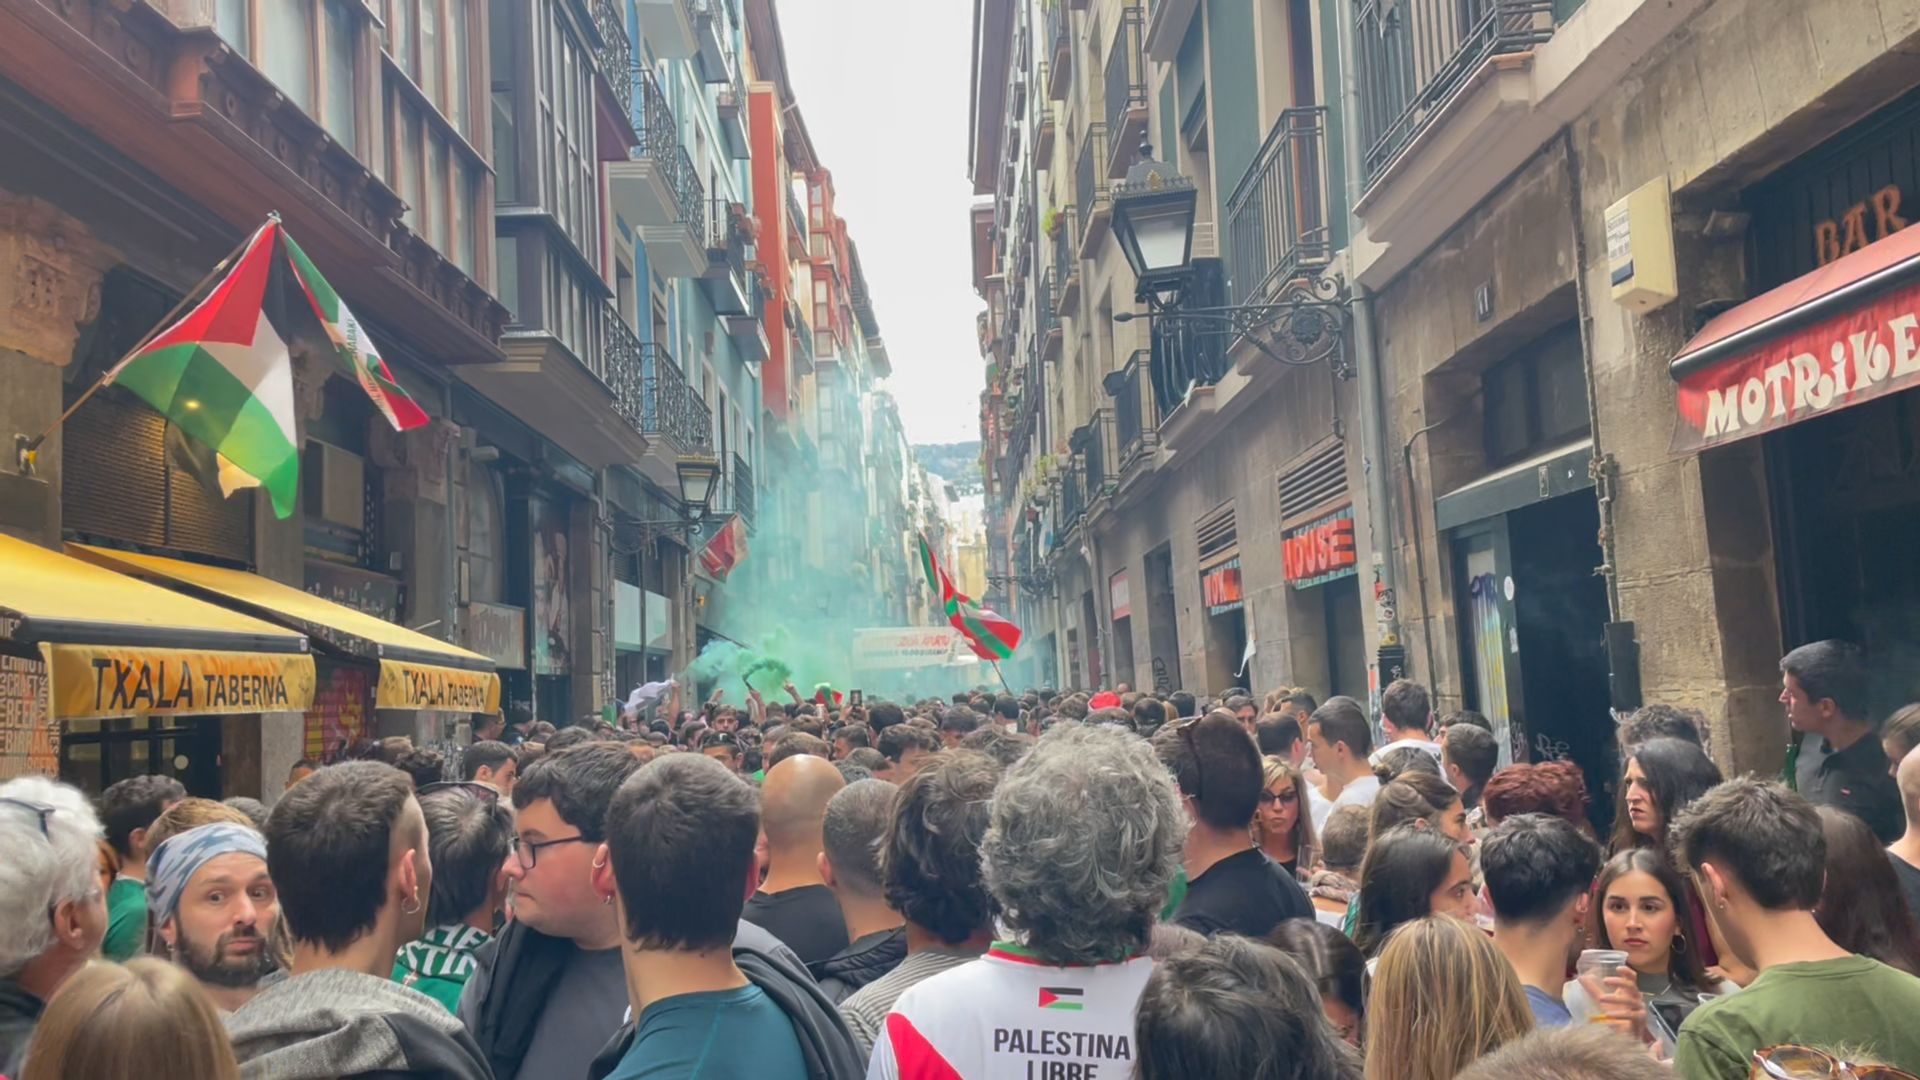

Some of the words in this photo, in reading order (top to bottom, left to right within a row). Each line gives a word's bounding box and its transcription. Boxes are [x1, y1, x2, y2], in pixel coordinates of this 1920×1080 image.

[1815, 184, 1908, 267] BAR
[92, 658, 194, 710] TXALA
[203, 674, 289, 707] TABERNA
[403, 670, 445, 705] TXALA
[448, 683, 484, 707] TABERNA
[993, 1028, 1131, 1060] PALESTINA
[1027, 1060, 1098, 1080] LIBRE
